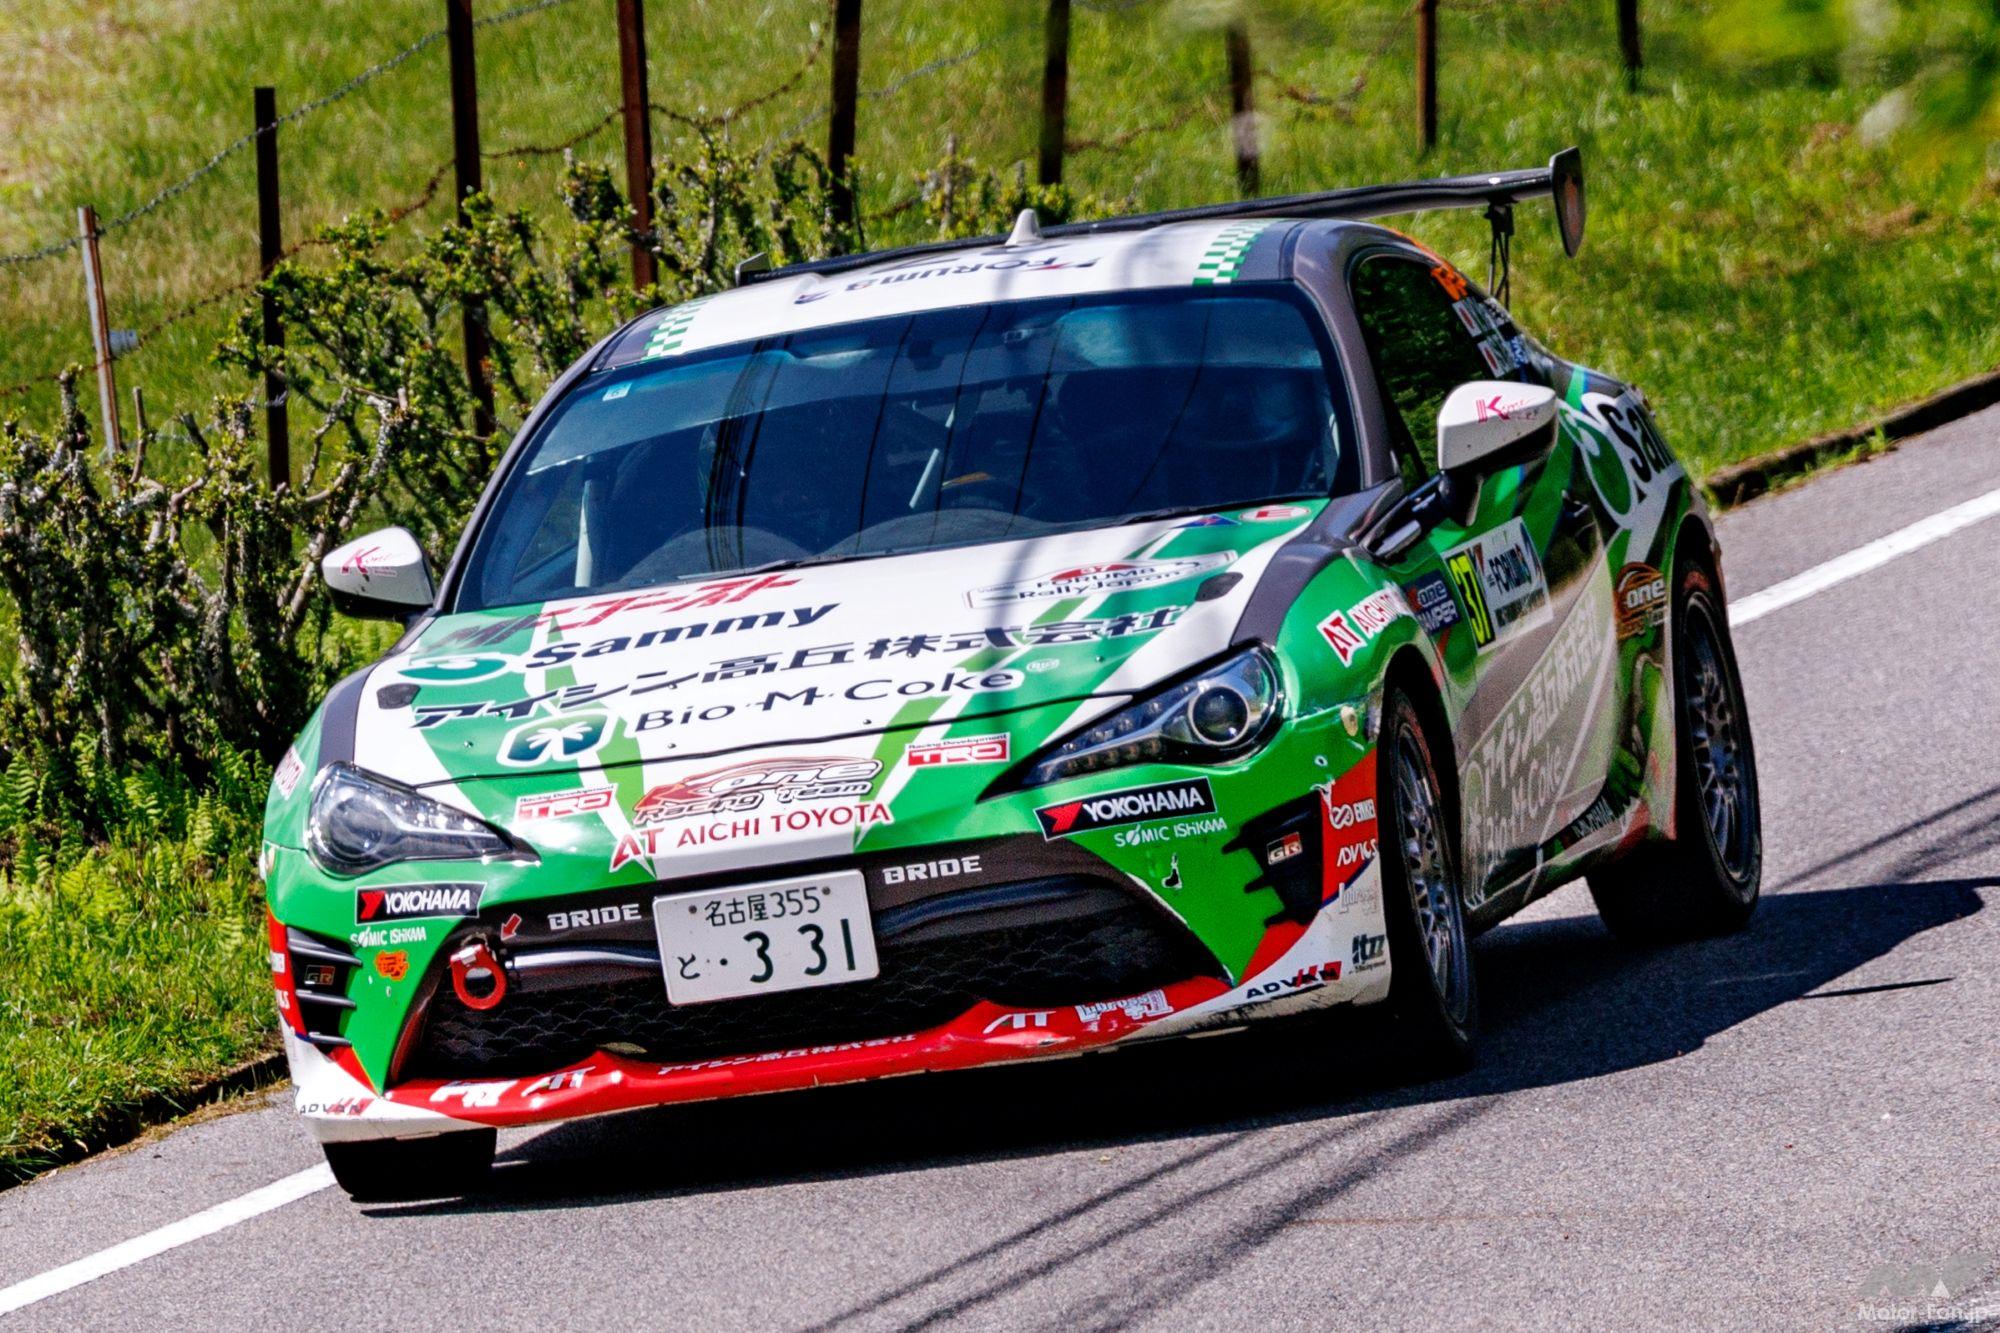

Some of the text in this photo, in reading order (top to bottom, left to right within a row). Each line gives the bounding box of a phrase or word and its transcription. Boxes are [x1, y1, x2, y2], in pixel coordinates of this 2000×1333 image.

[1449, 554, 1492, 645] 37
[911, 743, 1003, 764] TRD
[1082, 787, 1206, 822] YOKOHAMA
[676, 817, 760, 848] AICHI
[769, 801, 890, 833] TOYOTA
[1270, 840, 1303, 863] GR
[882, 855, 983, 885] BRIDE
[384, 889, 471, 912] YOKOHAMA
[548, 903, 643, 931] BRIDE
